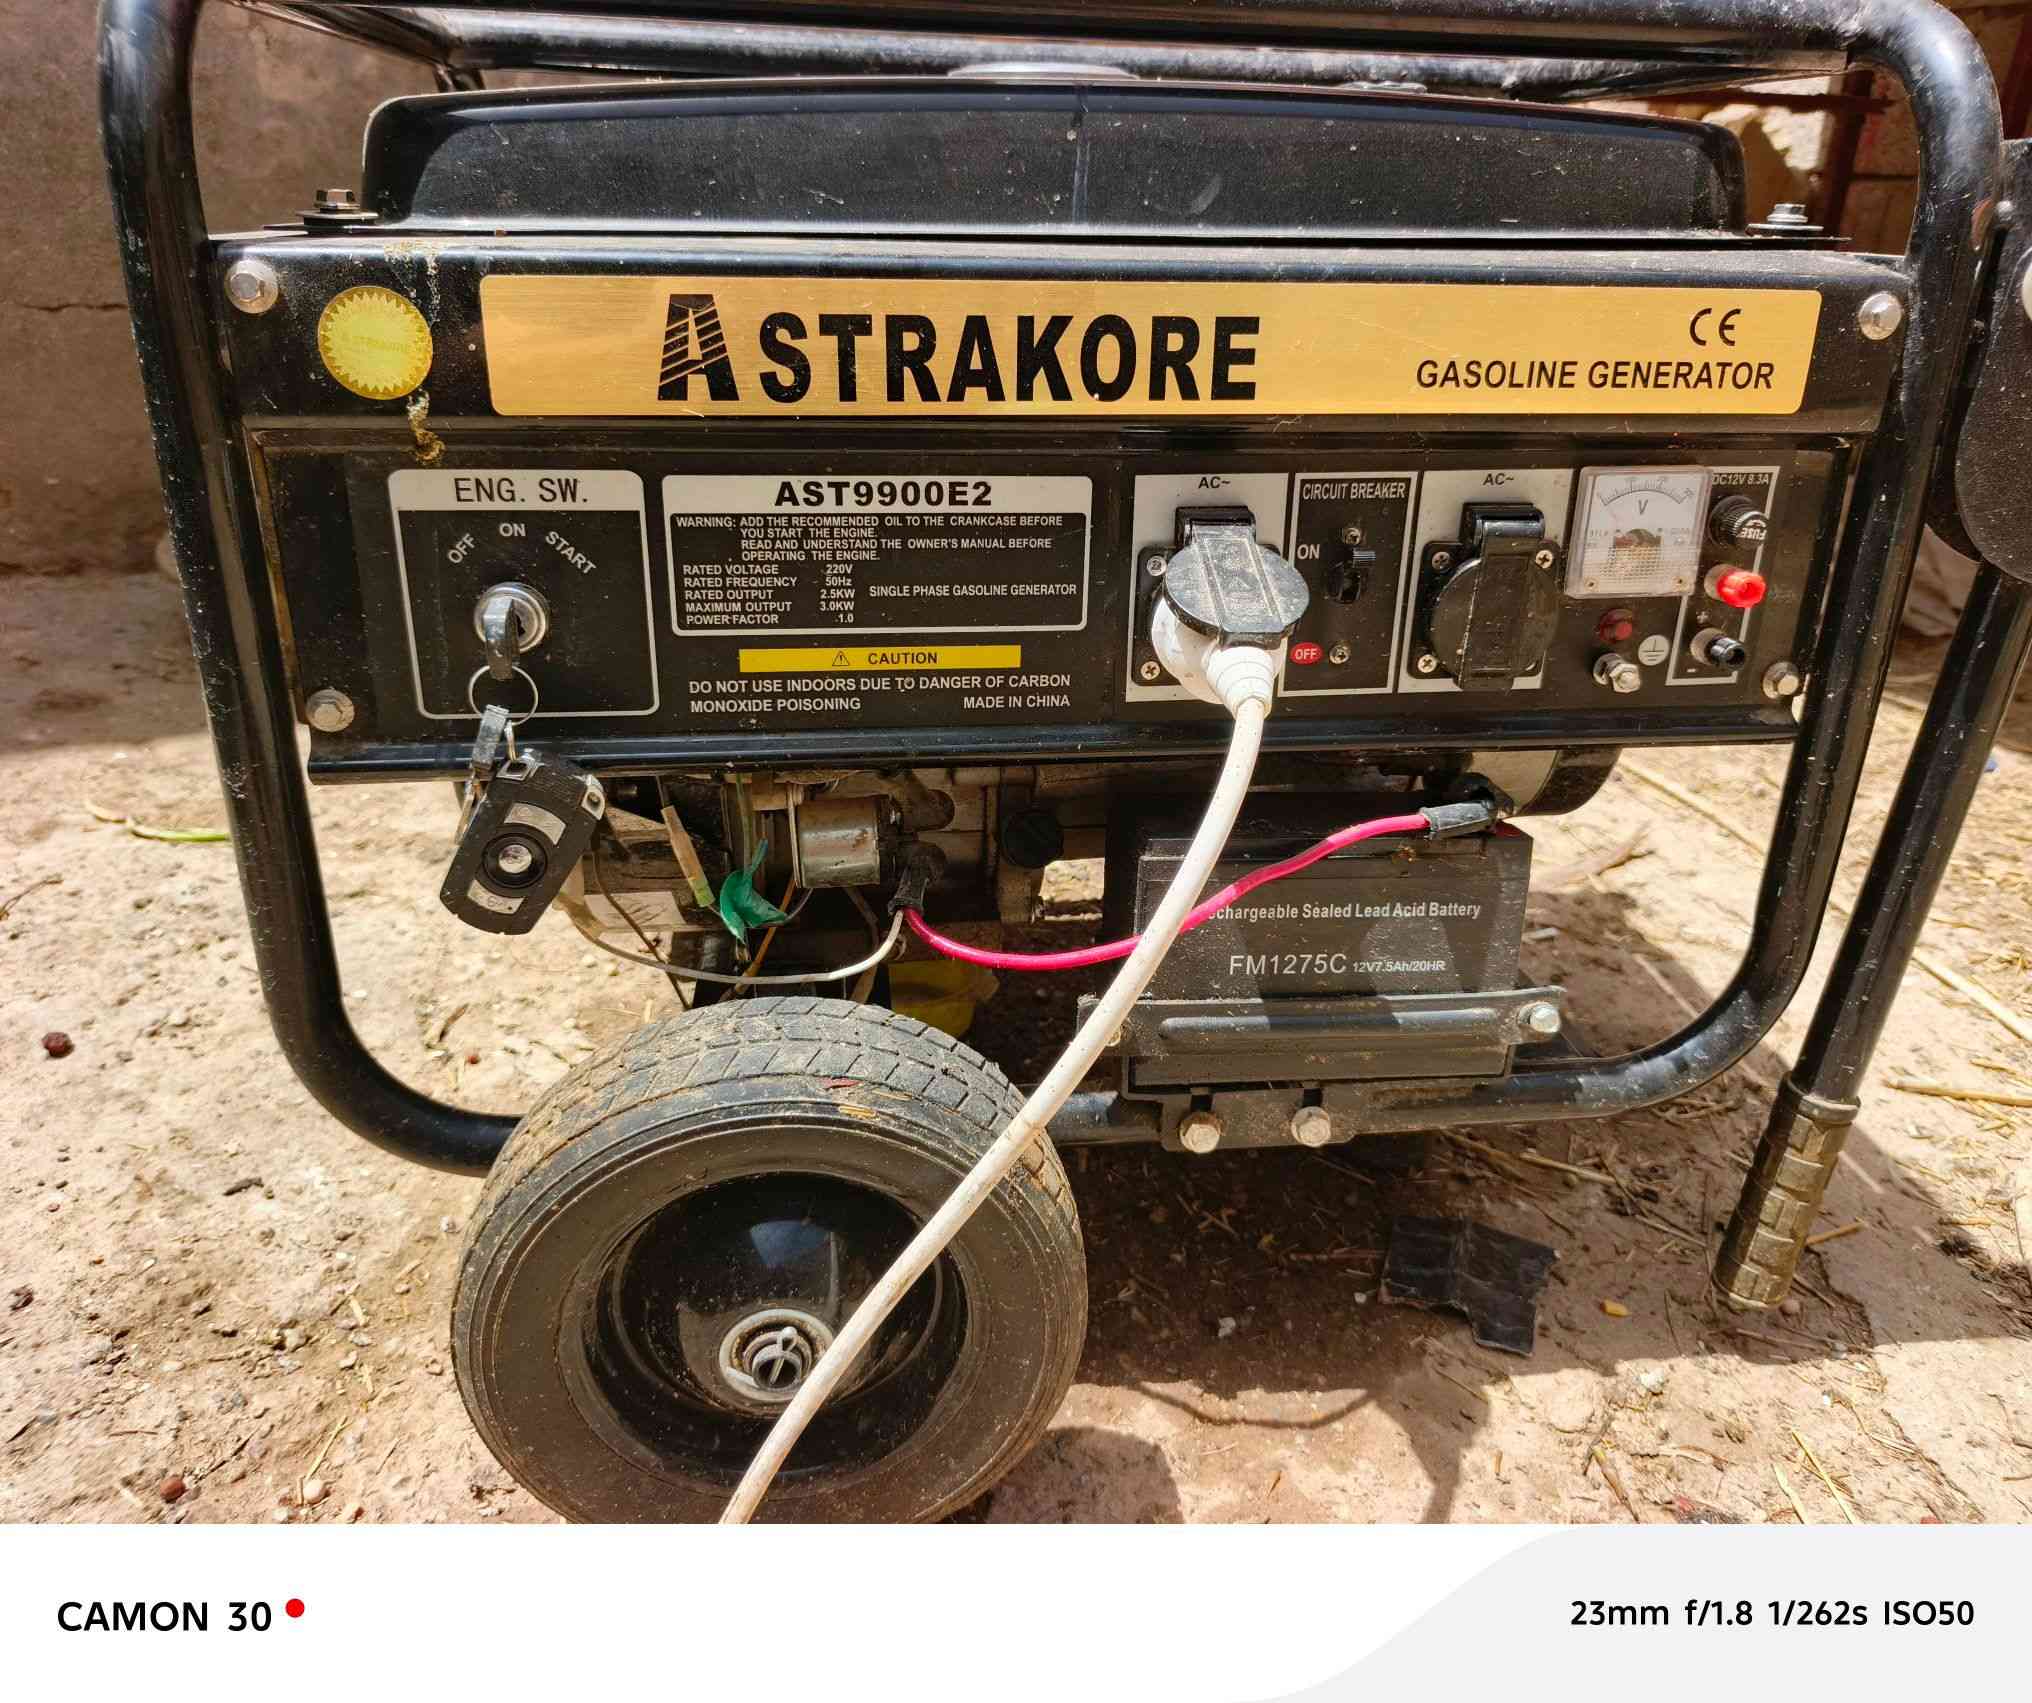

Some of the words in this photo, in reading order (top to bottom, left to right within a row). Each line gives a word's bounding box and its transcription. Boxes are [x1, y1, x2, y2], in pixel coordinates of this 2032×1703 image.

[1689, 308, 1742, 346] CE
[657, 293, 1260, 402] ASTRAKORE
[1416, 360, 1578, 389] GASOLINE
[1588, 361, 1775, 390] GENERATOR
[1712, 473, 1746, 485] DC12V
[454, 477, 526, 503] ENG.
[538, 478, 589, 503] SW.
[774, 481, 992, 507] AST9900E2
[1303, 483, 1349, 500] CIRCUIT
[1350, 482, 1406, 499] BREAKER
[1638, 499, 1649, 515] V
[676, 516, 736, 528] WARNING:
[740, 516, 764, 527] ADD
[767, 516, 789, 527] THE
[791, 516, 879, 527] RECOMMENDED
[884, 516, 903, 526] OIL
[906, 516, 921, 526] TO
[923, 516, 945, 526] THE
[950, 516, 1017, 526] CRANKCASE
[1019, 516, 1063, 526] BEFORE
[499, 523, 526, 537] ON
[741, 527, 765, 538] YOU
[767, 527, 803, 538] START
[809, 527, 831, 538] THE
[833, 527, 878, 538] ENGINE.
[447, 532, 477, 564] OFF
[741, 539, 773, 550] READ
[774, 539, 798, 550] AND
[803, 538, 878, 549] UNDERSTAND
[881, 538, 903, 549] THE
[907, 538, 958, 549] OWNER'S
[961, 538, 1006, 549] MANUAL
[1008, 538, 1052, 548] BEFORE
[1297, 543, 1320, 560] ON
[545, 531, 597, 575] START
[742, 550, 806, 561] OPERATING
[812, 550, 834, 561] THE
[836, 550, 881, 561] ENGINE.
[683, 564, 722, 575] RATED
[725, 564, 779, 575] VOLTAGE
[826, 563, 853, 574] 220V
[684, 577, 723, 588] RATED
[726, 576, 797, 588] FREQUENCY
[825, 576, 852, 587] 50Hz
[685, 590, 723, 601] RATED
[726, 589, 773, 600] OUTPUT
[820, 588, 855, 599] 2.5KW
[869, 585, 911, 597] SINGLE
[912, 585, 950, 597] PHASE
[952, 585, 1008, 596] GASOLINE
[1010, 584, 1077, 596] GENERATOR
[685, 602, 742, 613] MAXIMUM
[745, 601, 793, 612] OUTPUT
[820, 601, 855, 612] 3.0KW
[686, 615, 732, 625] POWER
[732, 614, 779, 625] FACTOR
[838, 614, 854, 623] 1.0
[868, 652, 938, 665] CAUTION
[1295, 649, 1318, 660] OFF
[689, 681, 712, 694] DO
[716, 680, 748, 693] NOT
[752, 680, 783, 693] USE
[787, 678, 856, 692] INDOORS
[860, 677, 891, 691] DUE
[895, 677, 915, 690] TO
[919, 676, 981, 689] DANGER
[985, 676, 1005, 688] OF
[1008, 674, 1071, 688] CARBON
[690, 699, 773, 713] MONOXIDE
[777, 697, 861, 711] POISONING
[963, 696, 1005, 709] MADE
[1008, 696, 1022, 708] IN
[1026, 694, 1071, 708] CHINA
[1302, 904, 1351, 918] Sealed
[1355, 903, 1390, 917] Lead
[1393, 903, 1425, 917] Acid
[1429, 902, 1481, 919] Battery
[1229, 953, 1347, 975] FM1275C
[1352, 960, 1446, 973] 12V7.5Ah/20HR
